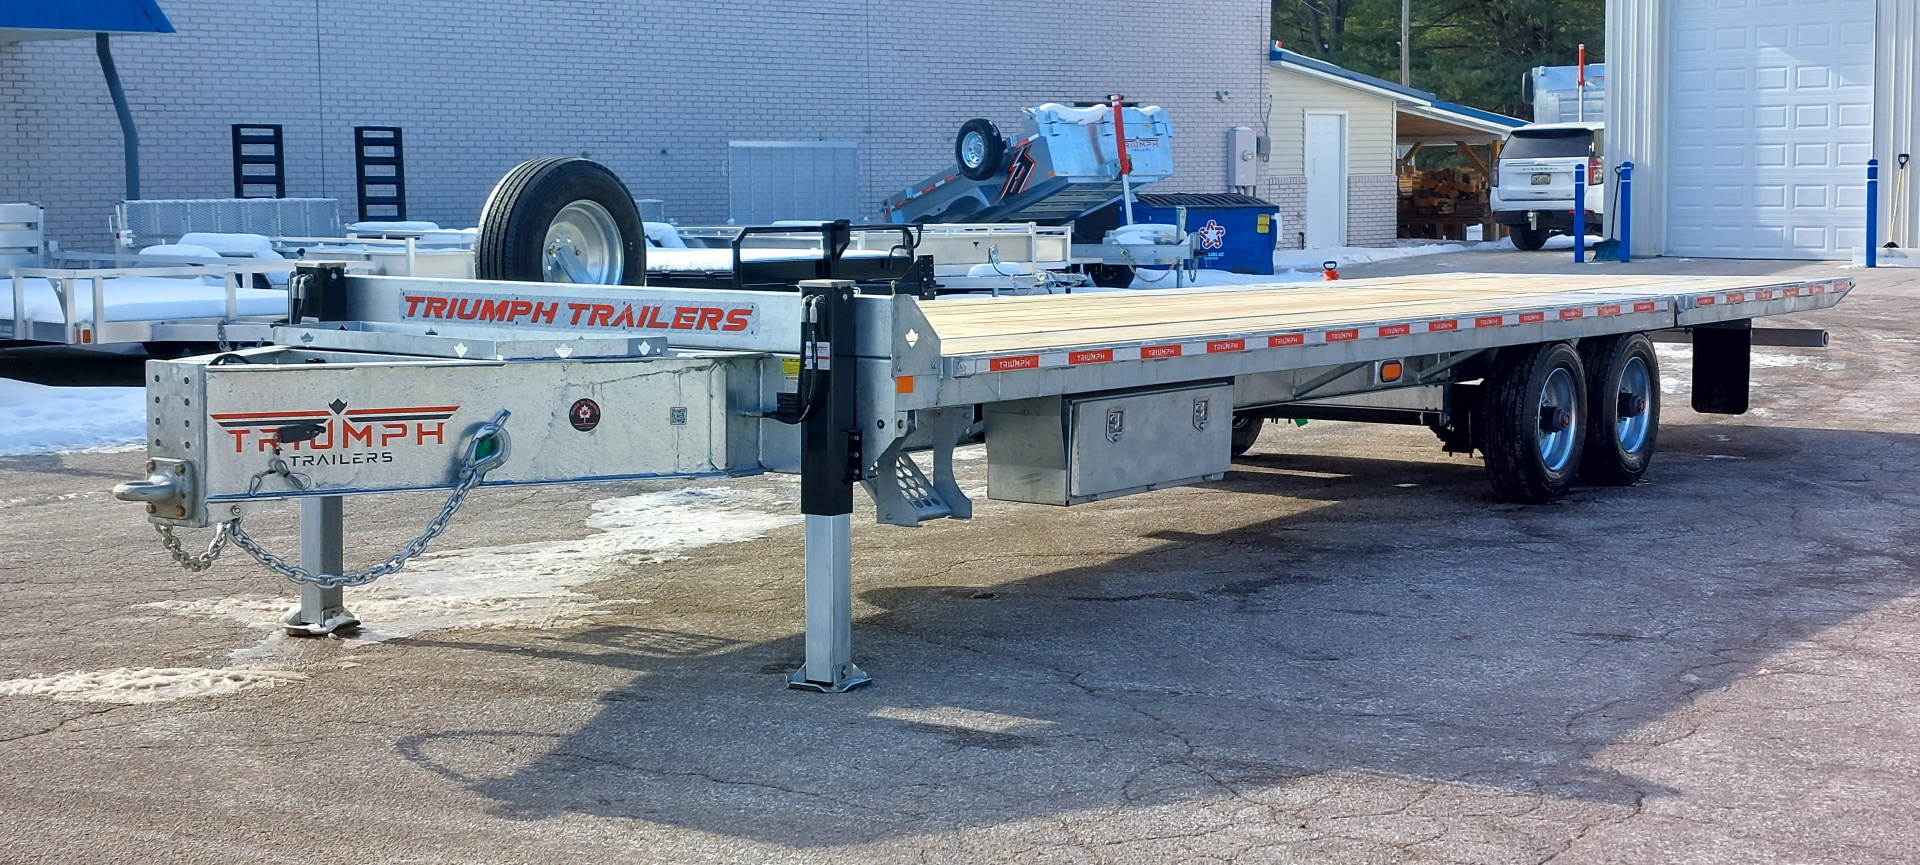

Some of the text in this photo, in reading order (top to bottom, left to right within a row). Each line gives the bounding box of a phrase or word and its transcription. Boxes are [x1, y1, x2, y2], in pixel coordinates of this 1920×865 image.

[404, 296, 753, 331] TRIUMPH TRAILERS
[1274, 337, 1298, 345] TRIUMPH
[1213, 342, 1239, 351] TRIUMPH
[1148, 348, 1175, 357] TRIUMPH
[1076, 353, 1105, 362] TRIUMPH
[999, 359, 1030, 369] TRIUMPH
[290, 451, 393, 467] TRAILERS
